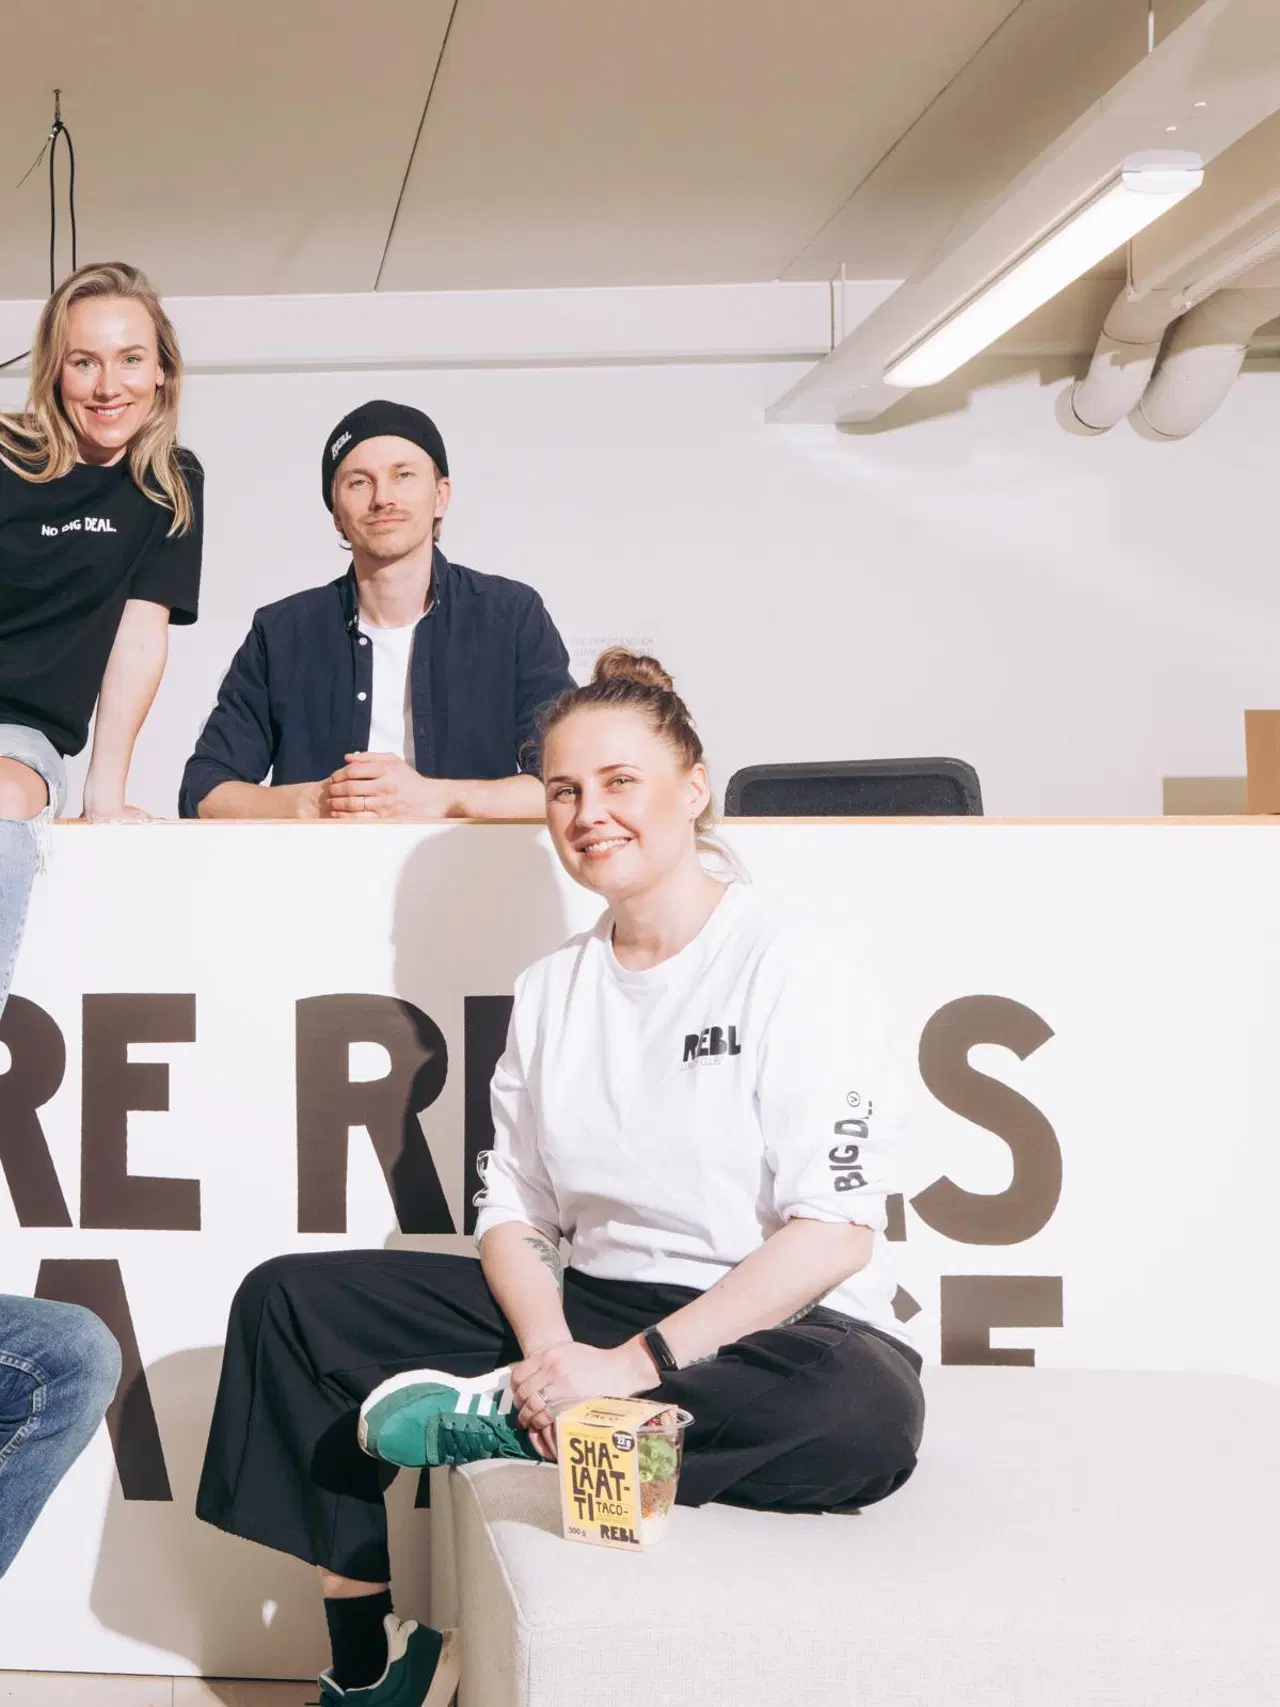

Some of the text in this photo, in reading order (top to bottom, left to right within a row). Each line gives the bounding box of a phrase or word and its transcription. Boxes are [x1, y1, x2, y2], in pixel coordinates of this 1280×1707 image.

[85, 517, 117, 532] DEAL.
[683, 1025, 741, 1062] REBL
[828, 1144, 869, 1192] BIG
[569, 1437, 620, 1469] SHA-
[572, 1465, 631, 1501] LAAT-
[574, 1493, 594, 1521] TI
[595, 1501, 629, 1516] TACO-
[600, 1524, 640, 1544] REBL
